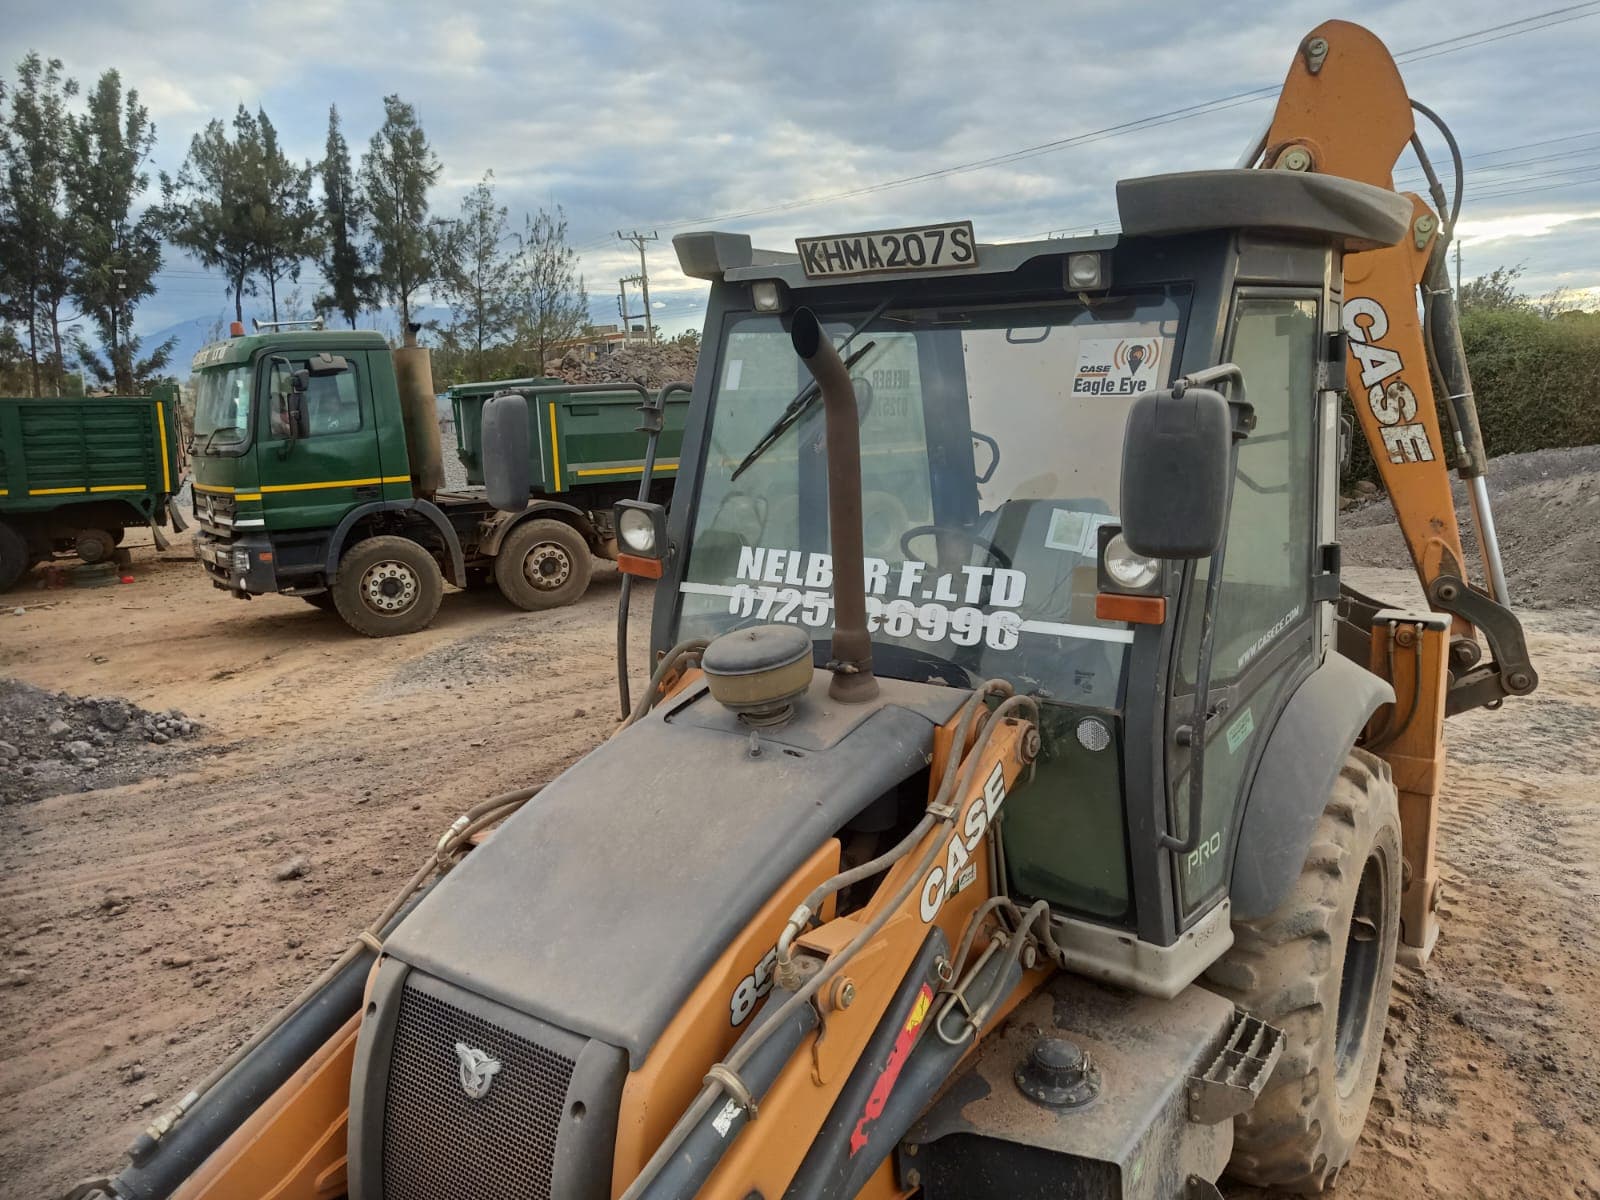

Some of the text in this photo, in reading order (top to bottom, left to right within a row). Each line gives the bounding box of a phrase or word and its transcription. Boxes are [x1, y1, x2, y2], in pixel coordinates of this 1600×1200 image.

[801, 228, 972, 274] KHMA207S
[1073, 376, 1147, 395] Eagle Eye
[1080, 365, 1111, 373] CASE
[1342, 297, 1436, 464] CASE
[736, 546, 889, 594] NELBR
[728, 583, 1022, 650] 07256996
[920, 759, 1006, 924] CASE
[1188, 831, 1220, 875] PRO
